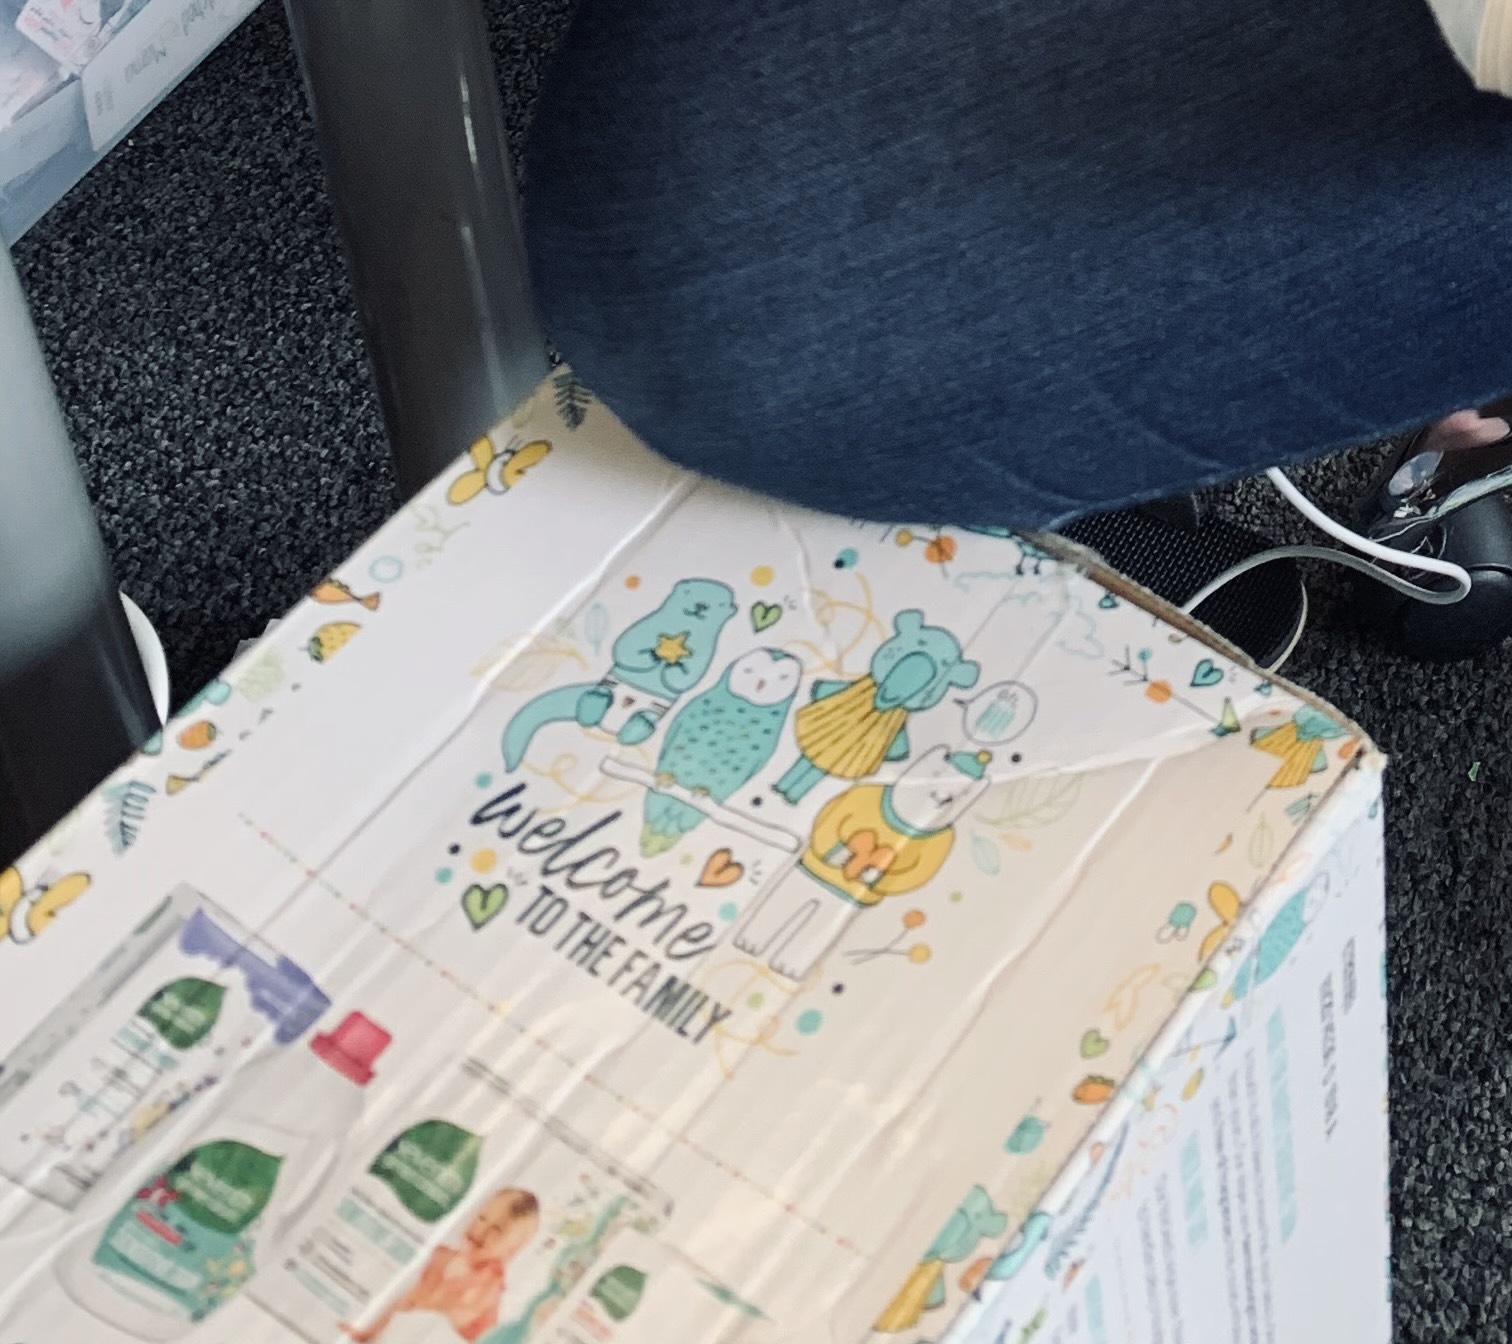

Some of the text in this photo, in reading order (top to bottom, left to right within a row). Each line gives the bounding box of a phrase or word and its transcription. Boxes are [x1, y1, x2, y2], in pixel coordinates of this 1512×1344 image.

[515, 884, 734, 1046] TO THE FAMILY
